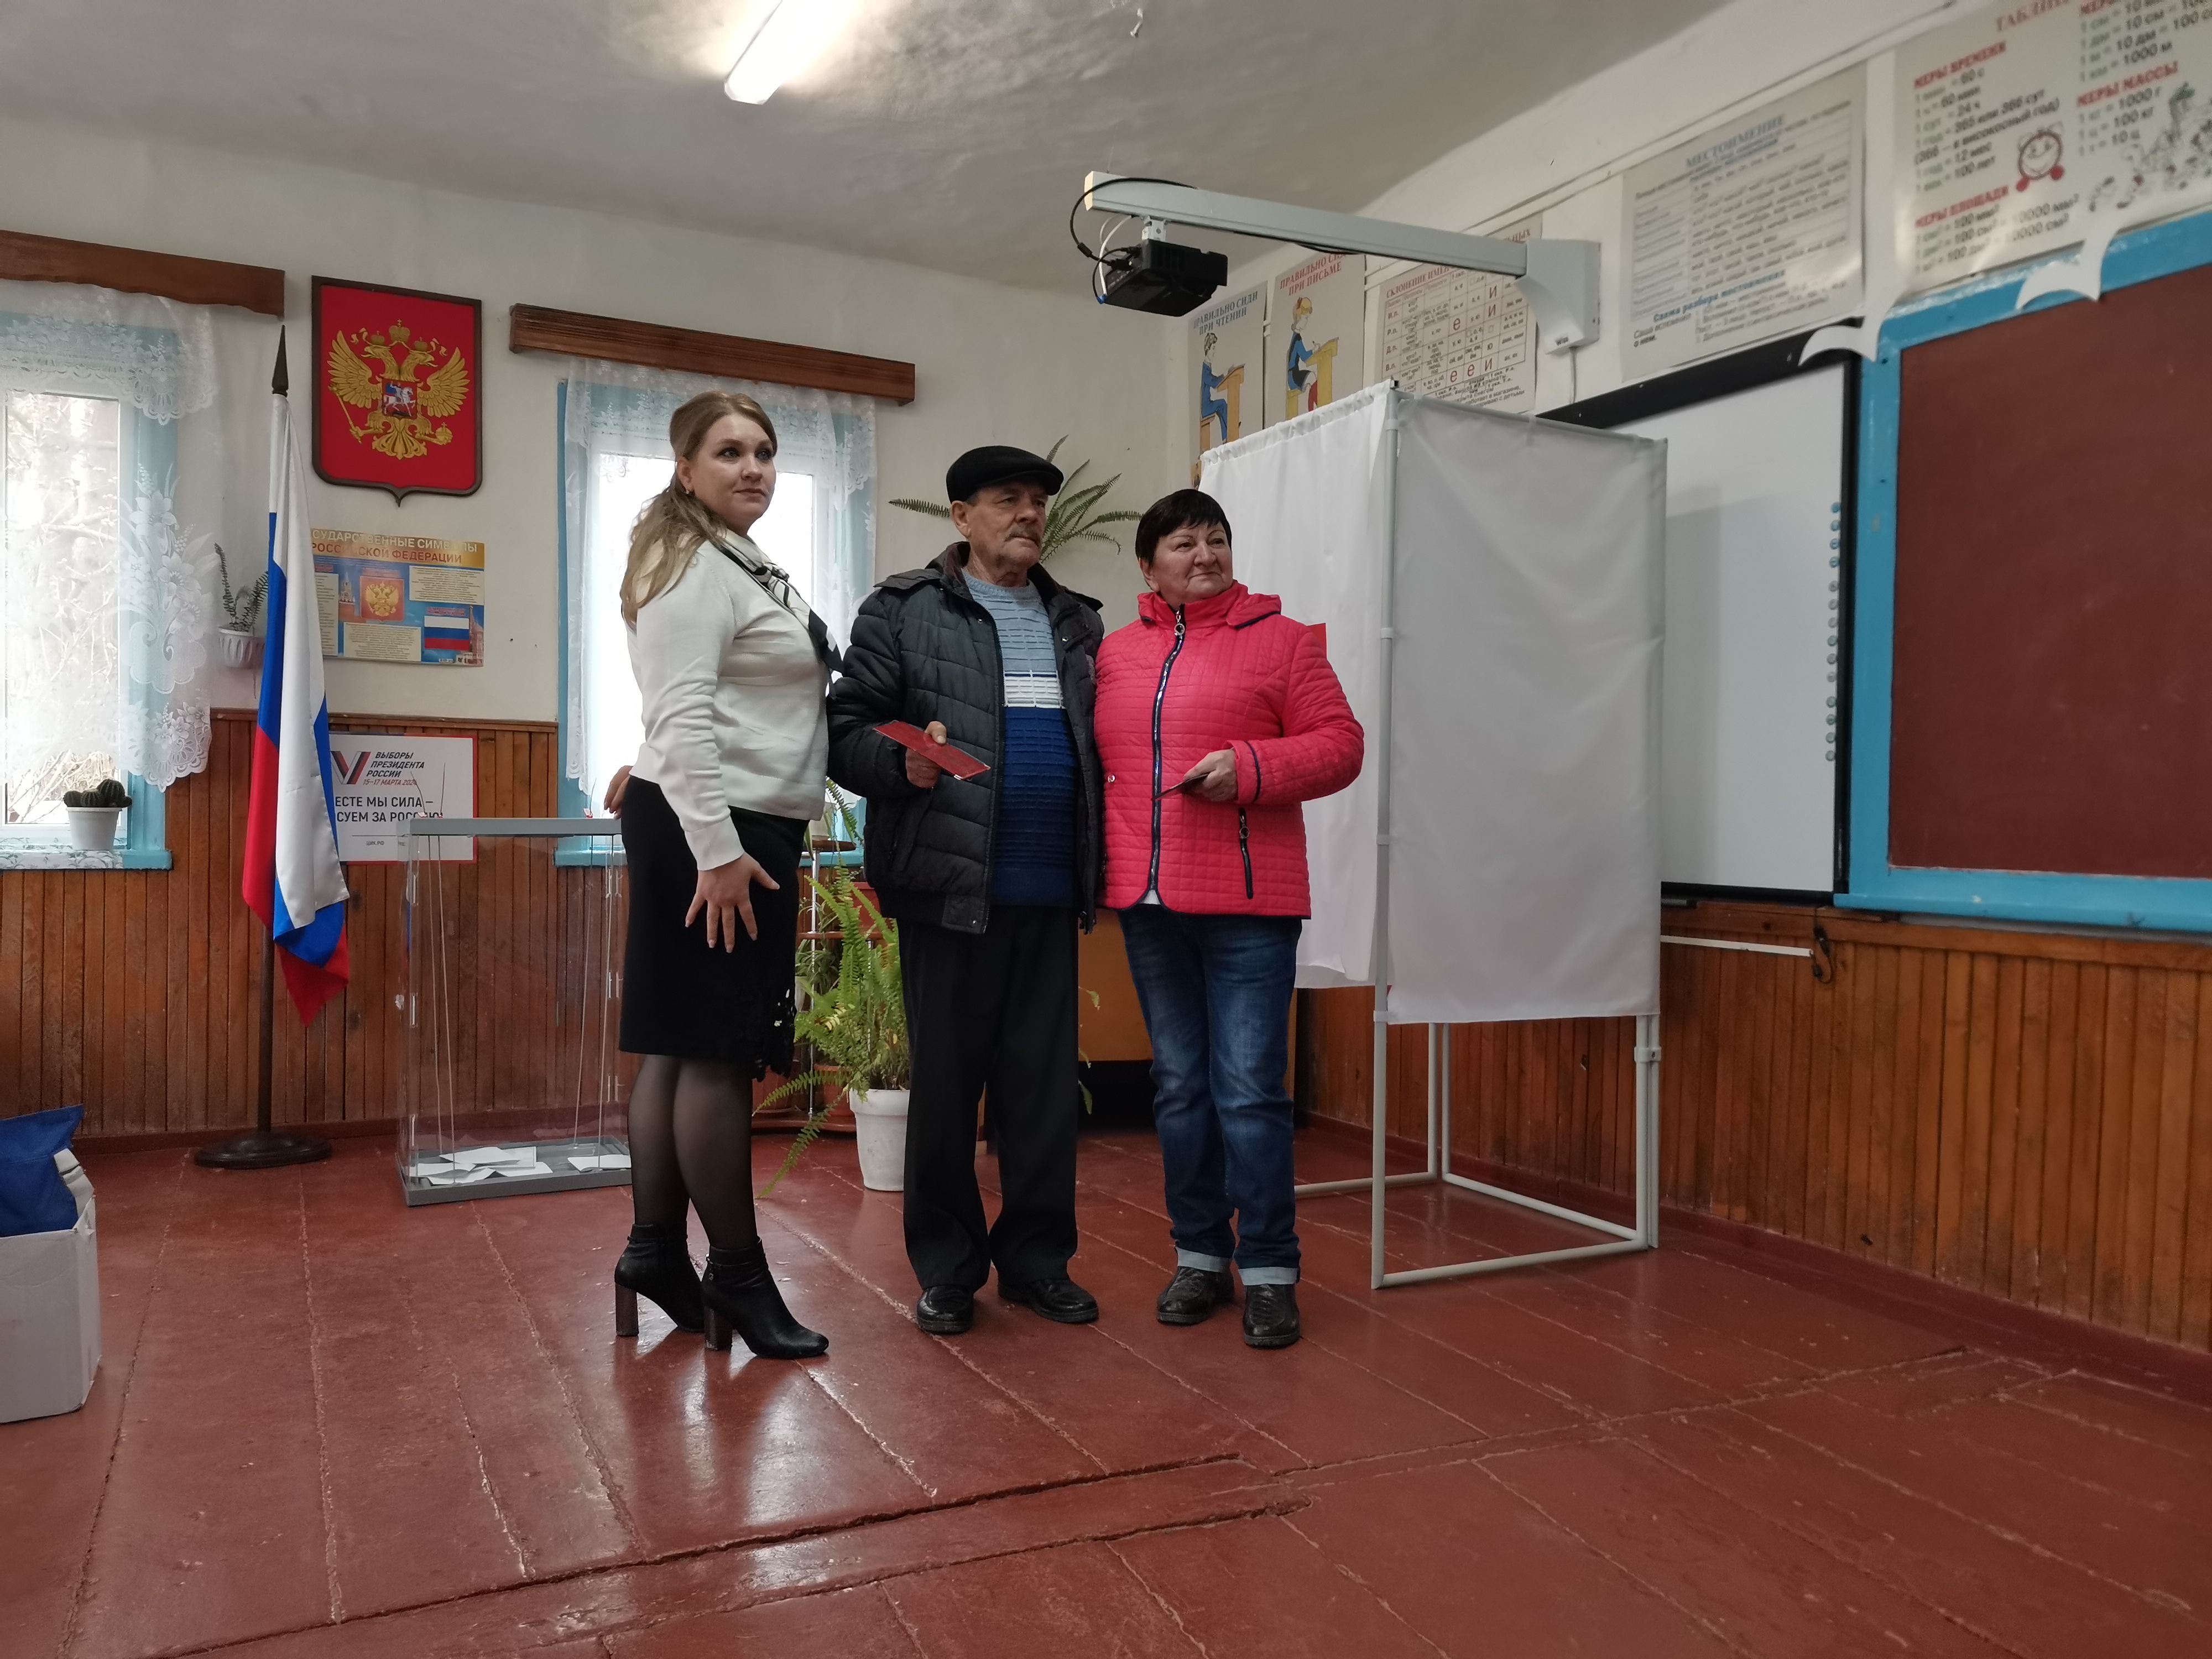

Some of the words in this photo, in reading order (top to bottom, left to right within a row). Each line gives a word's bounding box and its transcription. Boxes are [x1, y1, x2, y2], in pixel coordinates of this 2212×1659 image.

[2116, 35, 2133, 50] 10
[2173, 10, 2199, 30] 100
[2124, 43, 2158, 64] 1000
[2119, 87, 2153, 109] 1000
[2114, 109, 2140, 127] 100
[1280, 257, 1326, 289] ПРАВИЛЬНО
[1288, 283, 1304, 296] ПРИ
[1307, 262, 1342, 286] ПИСЬМЕ
[1193, 301, 1235, 329] ПРАВИЛЬНО
[1237, 291, 1258, 308] СИДИ
[1199, 322, 1213, 335] ПРИ
[1216, 307, 1247, 327] ЧТЕНИИ
[1453, 317, 1461, 331] е
[1450, 370, 1458, 383] е
[1467, 363, 1475, 377] е
[312, 529, 415, 548] СУДАРСВЕННЫЕ
[417, 538, 477, 552] СИМВЛЫ
[312, 542, 389, 557] РОСССКОЙ
[392, 550, 462, 563] ФЕДЕРАЦИИ
[335, 796, 363, 807] ЕСТЕ
[367, 797, 387, 807] МЫ
[391, 797, 422, 807] СИЛА
[337, 811, 368, 822] СУЕМ
[372, 812, 387, 822] ЗА
